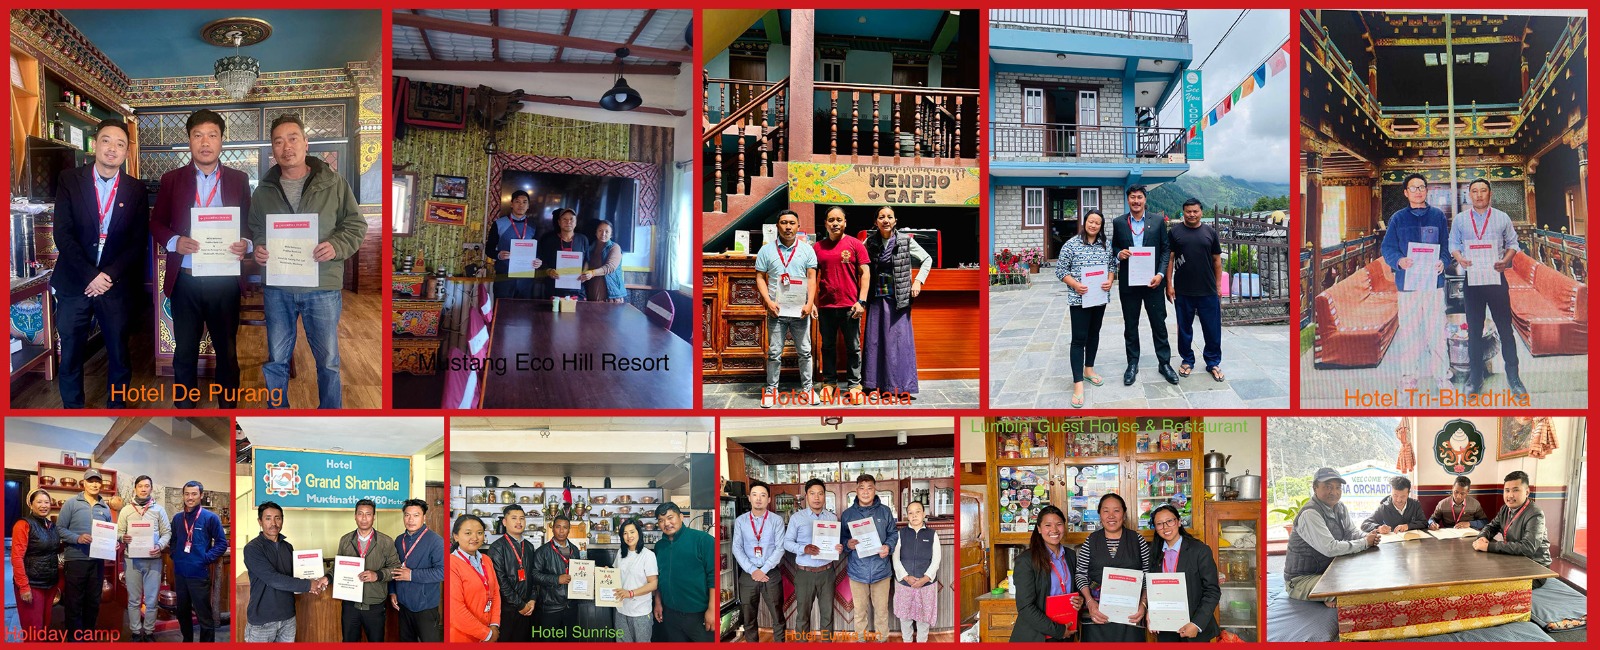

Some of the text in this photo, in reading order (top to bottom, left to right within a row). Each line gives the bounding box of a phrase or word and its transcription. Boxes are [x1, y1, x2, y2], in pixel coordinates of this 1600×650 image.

[1186, 84, 1200, 93] See
[1185, 92, 1201, 102] You
[869, 173, 951, 189] MENDHO
[884, 189, 936, 204] CAFE
[326, 459, 353, 469] Hotel
[305, 473, 400, 491] Grand Shambala
[1353, 484, 1393, 494] ORCHARD
